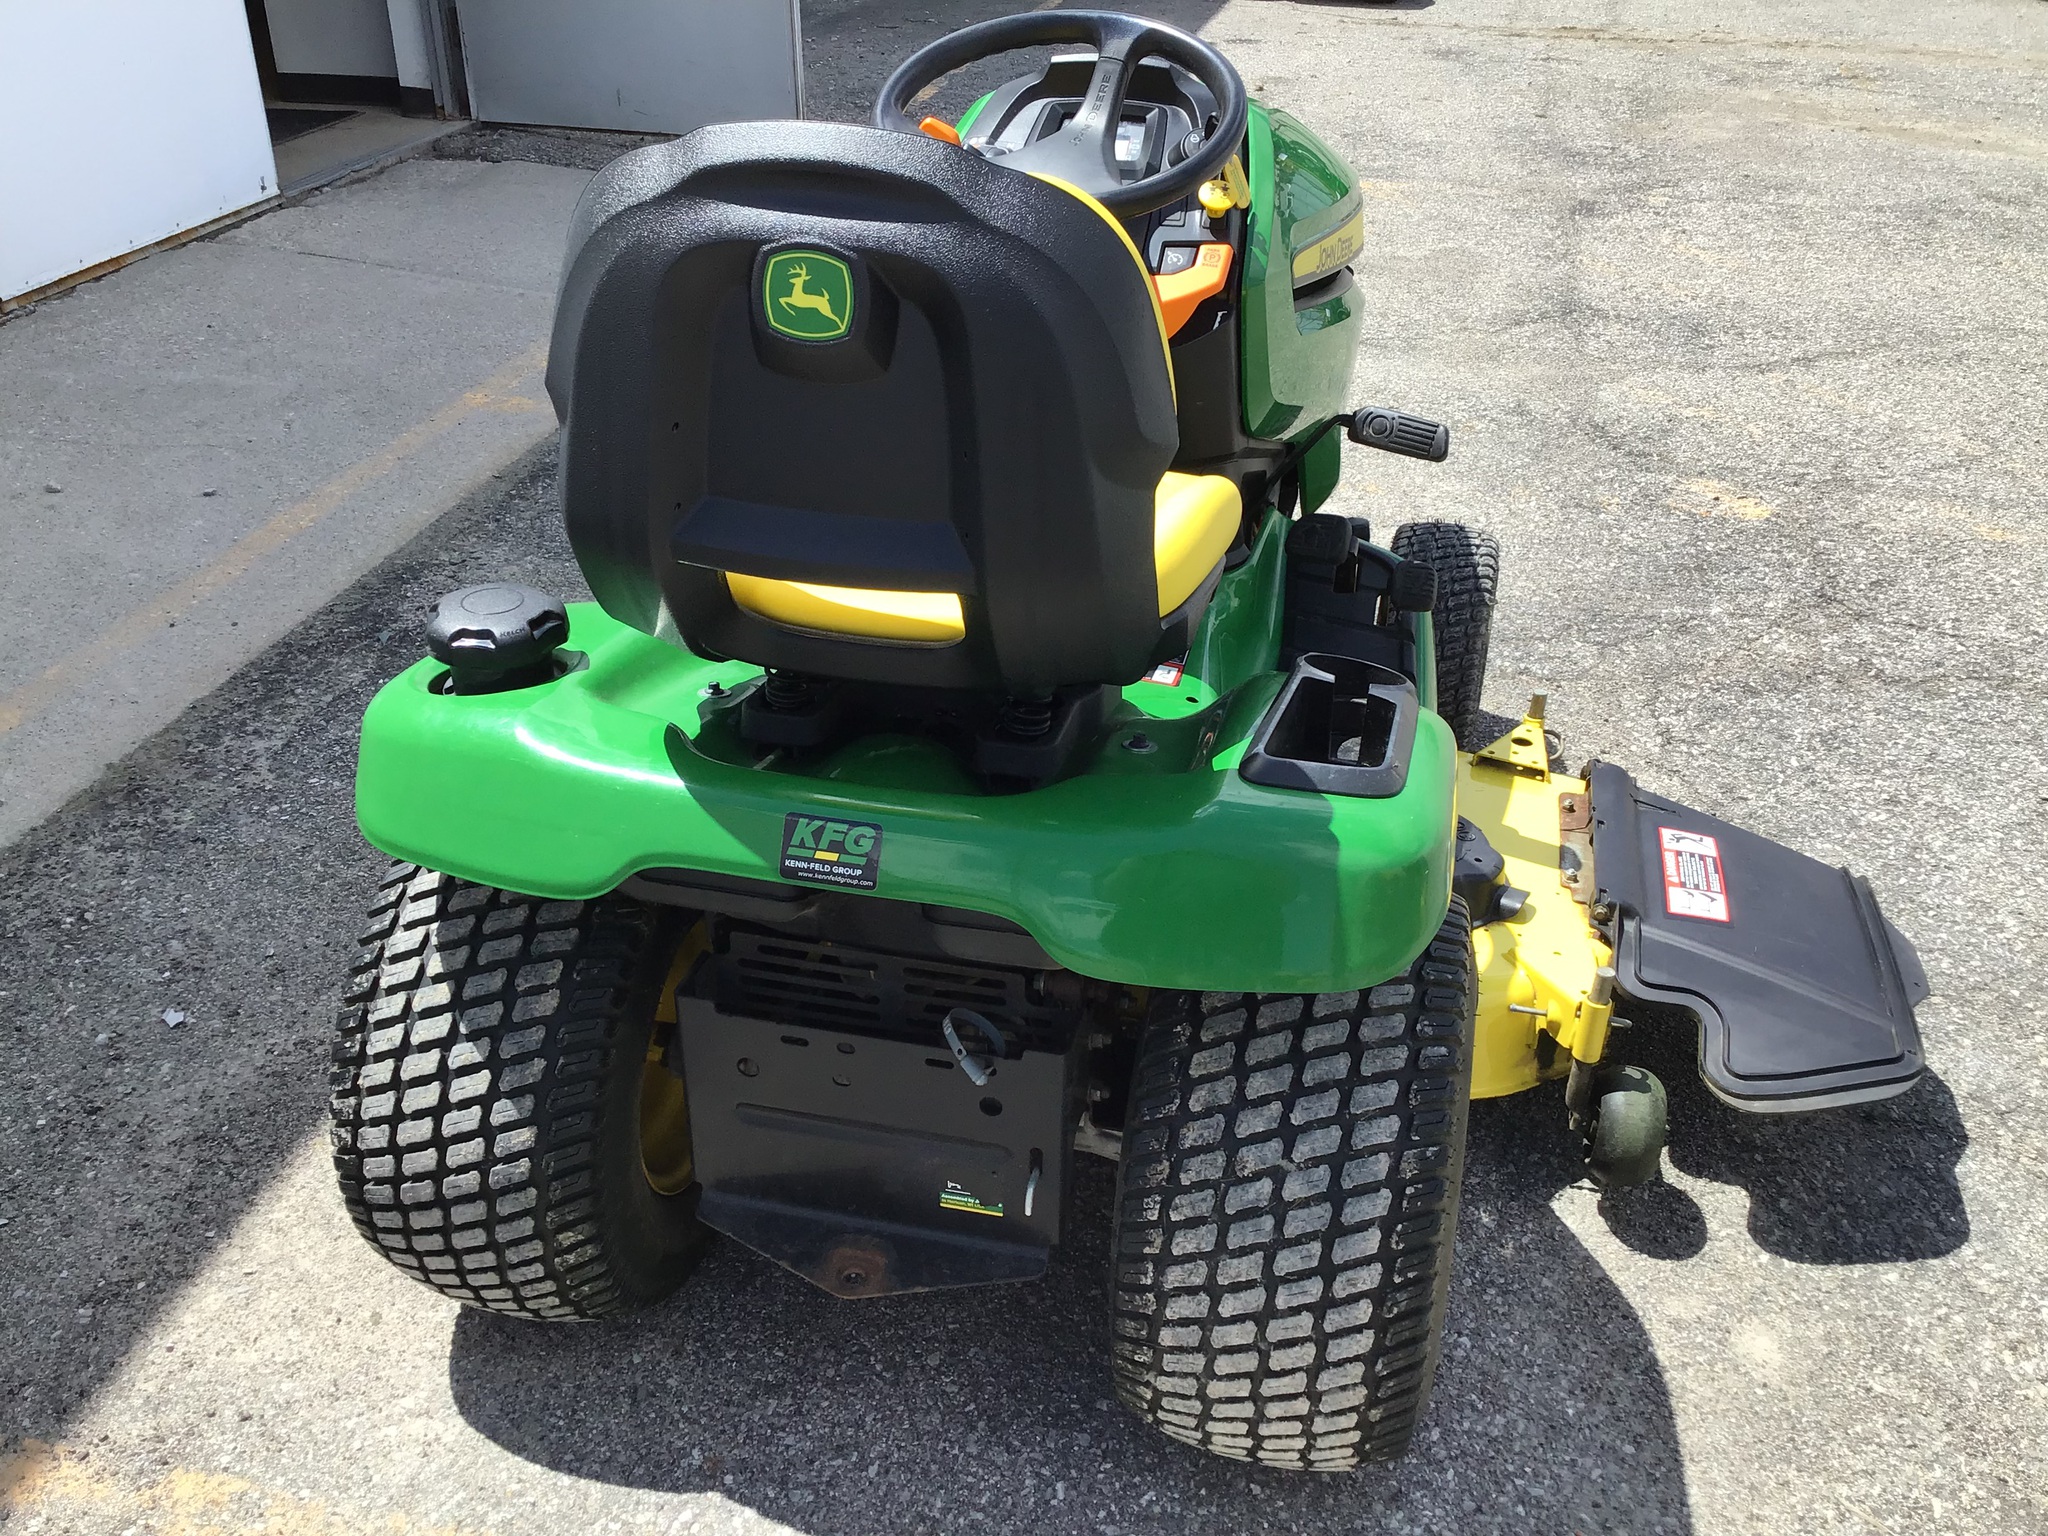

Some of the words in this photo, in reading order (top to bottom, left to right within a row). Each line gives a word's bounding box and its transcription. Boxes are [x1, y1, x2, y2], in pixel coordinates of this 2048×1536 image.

[1086, 74, 1112, 122] DEERE
[1316, 244, 1337, 273] JOHN
[1337, 235, 1354, 264] DEERE
[790, 817, 877, 855] KFG
[784, 858, 831, 873] KENN-FELD
[832, 865, 863, 877] GROUP
[797, 870, 874, 887] www.kennfeldgroup.com
[1664, 850, 1678, 876] DANGER
